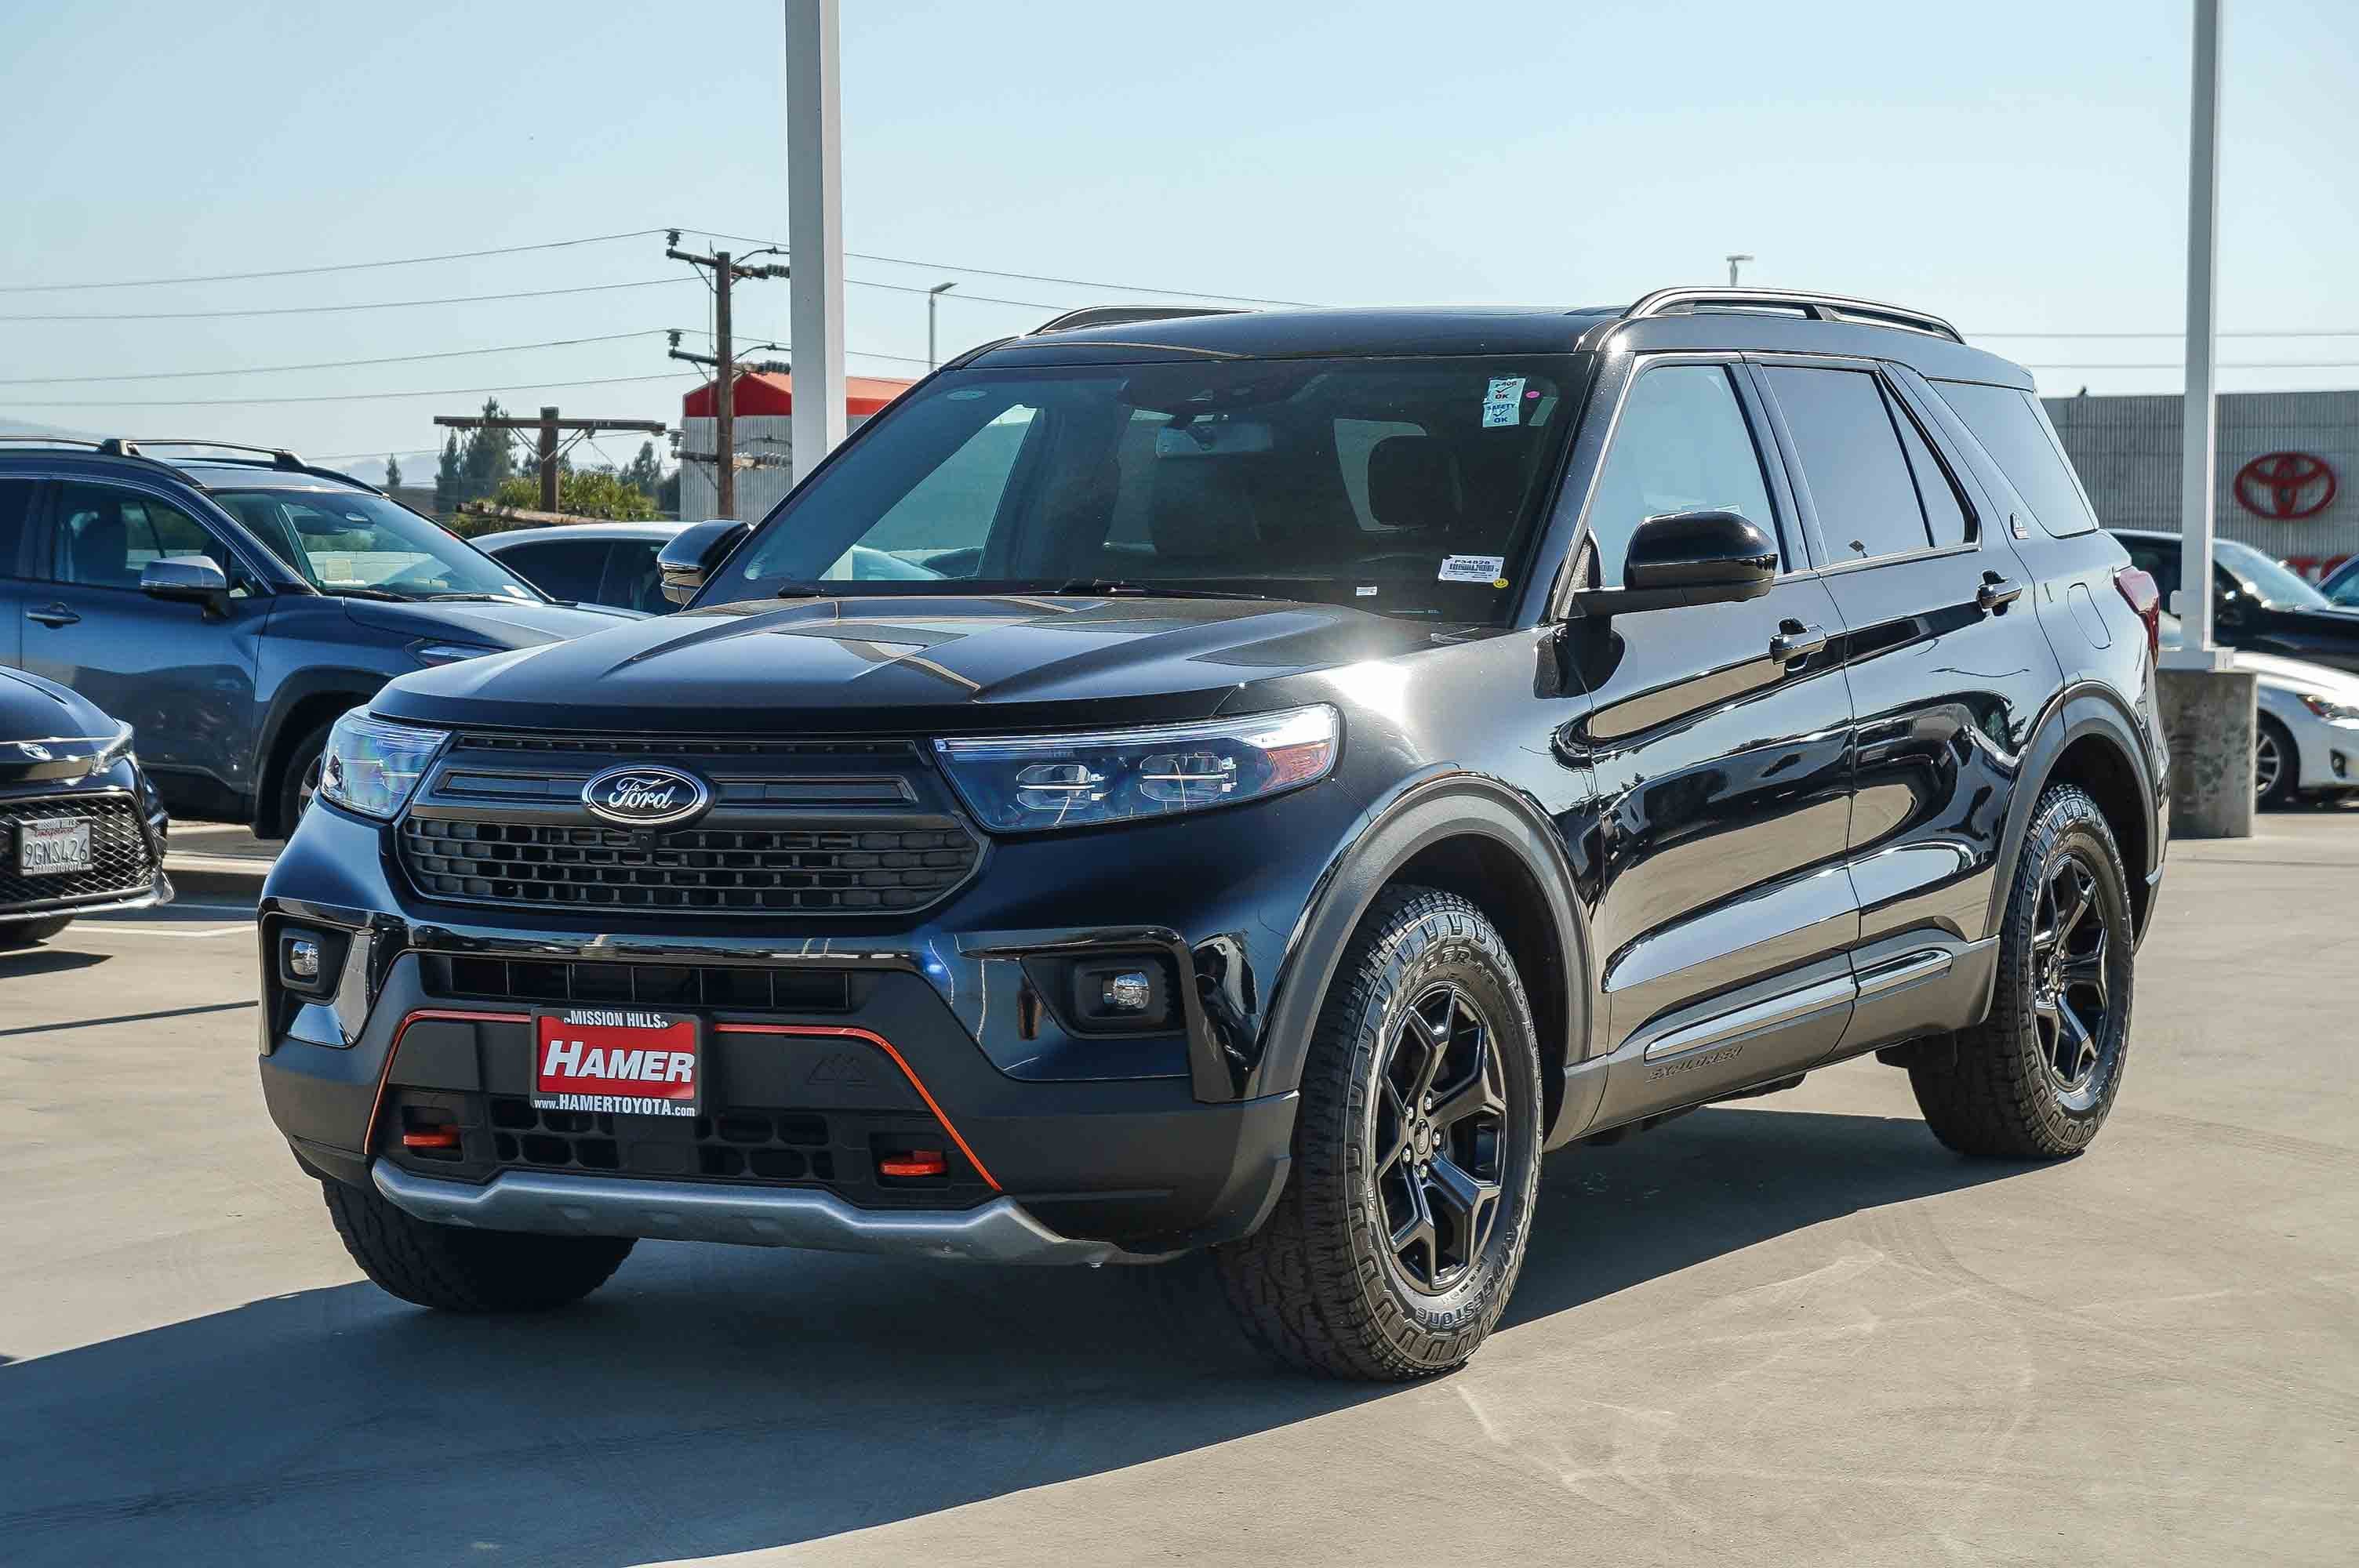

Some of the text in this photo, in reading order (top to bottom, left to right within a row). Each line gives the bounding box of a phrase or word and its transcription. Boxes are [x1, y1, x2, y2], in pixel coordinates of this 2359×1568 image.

[608, 777, 677, 809] Ford
[25, 838, 89, 867] 9GNS426
[570, 1010, 661, 1029] MISSION HILLS
[542, 1040, 696, 1083] HAMER
[533, 1094, 696, 1117] www.HAMERTOYOTA.com
